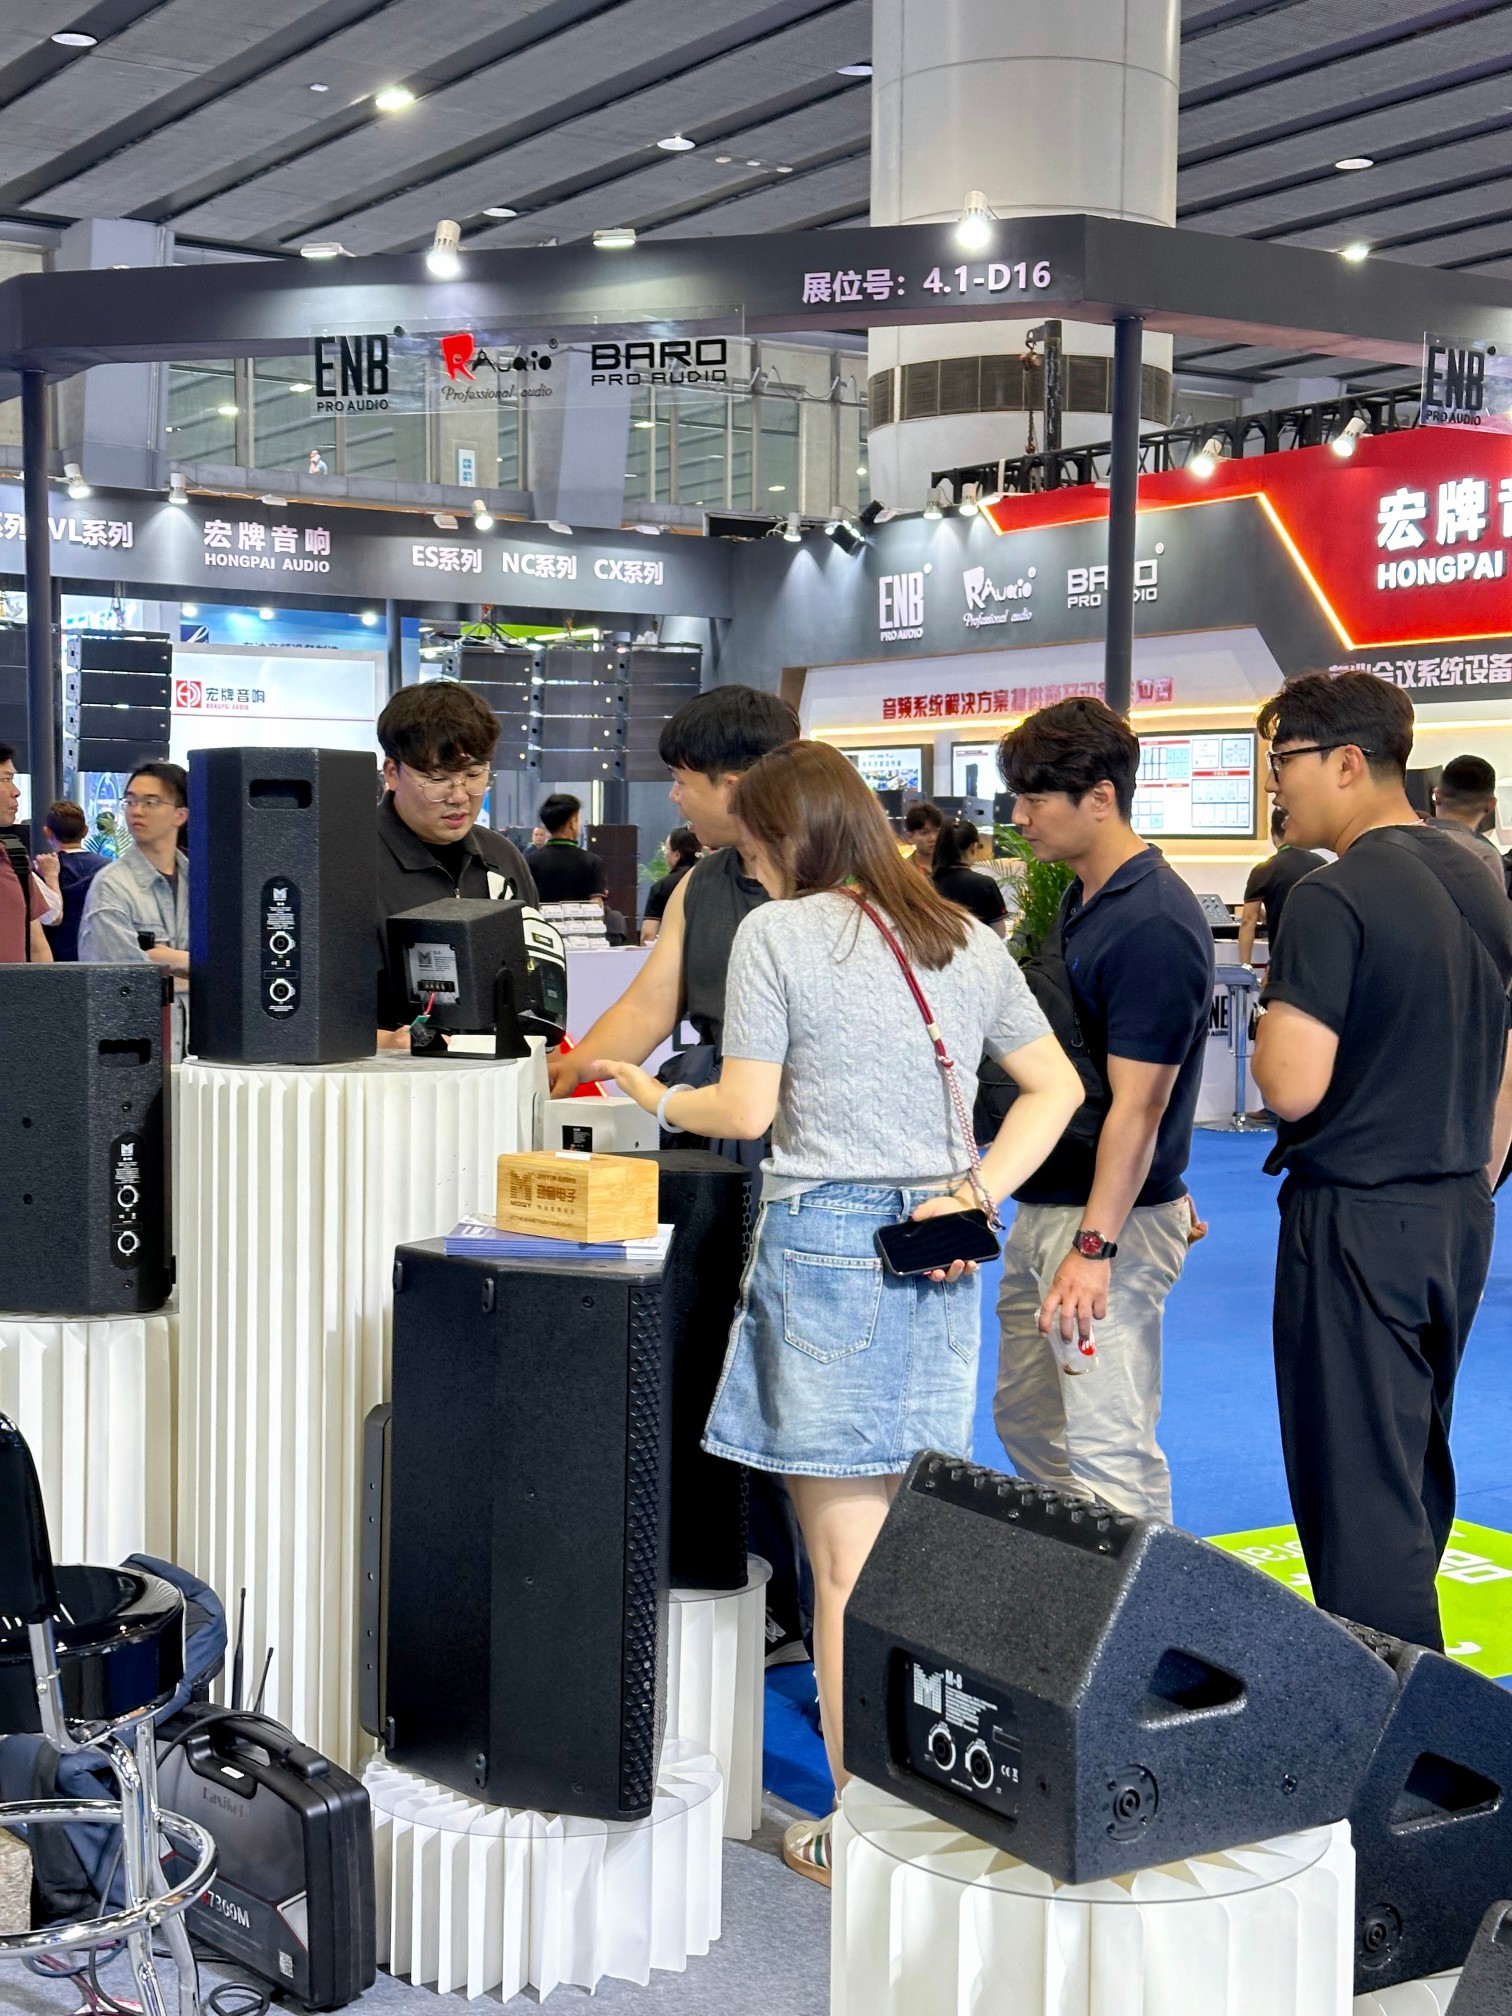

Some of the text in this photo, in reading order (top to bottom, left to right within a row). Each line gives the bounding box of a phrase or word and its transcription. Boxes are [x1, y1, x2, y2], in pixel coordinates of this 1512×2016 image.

[923, 261, 1051, 293] 4.1-D16
[315, 334, 389, 397] ENB
[592, 339, 727, 370] BARO
[441, 383, 553, 405] Professional audio
[592, 370, 727, 386] PRO AUDIO
[1426, 346, 1485, 411] ENB
[316, 399, 389, 412] PRO AUDIO
[1426, 409, 1482, 426] PRO AUDIO
[1377, 478, 1512, 546] 宏牌
[0, 512, 133, 548] 列 VL系列
[203, 519, 331, 556] 宏牌音响
[204, 552, 330, 573] HONGPAI AUDIO
[412, 545, 664, 585] ES系列 NC系列 CX系列
[1067, 559, 1158, 594] BAO
[1377, 550, 1504, 590] HONGPAI
[879, 571, 924, 629] ENB
[1068, 593, 1101, 608] PRO
[880, 628, 923, 642] PRO AUDIO
[206, 687, 265, 703] 宏牌音响
